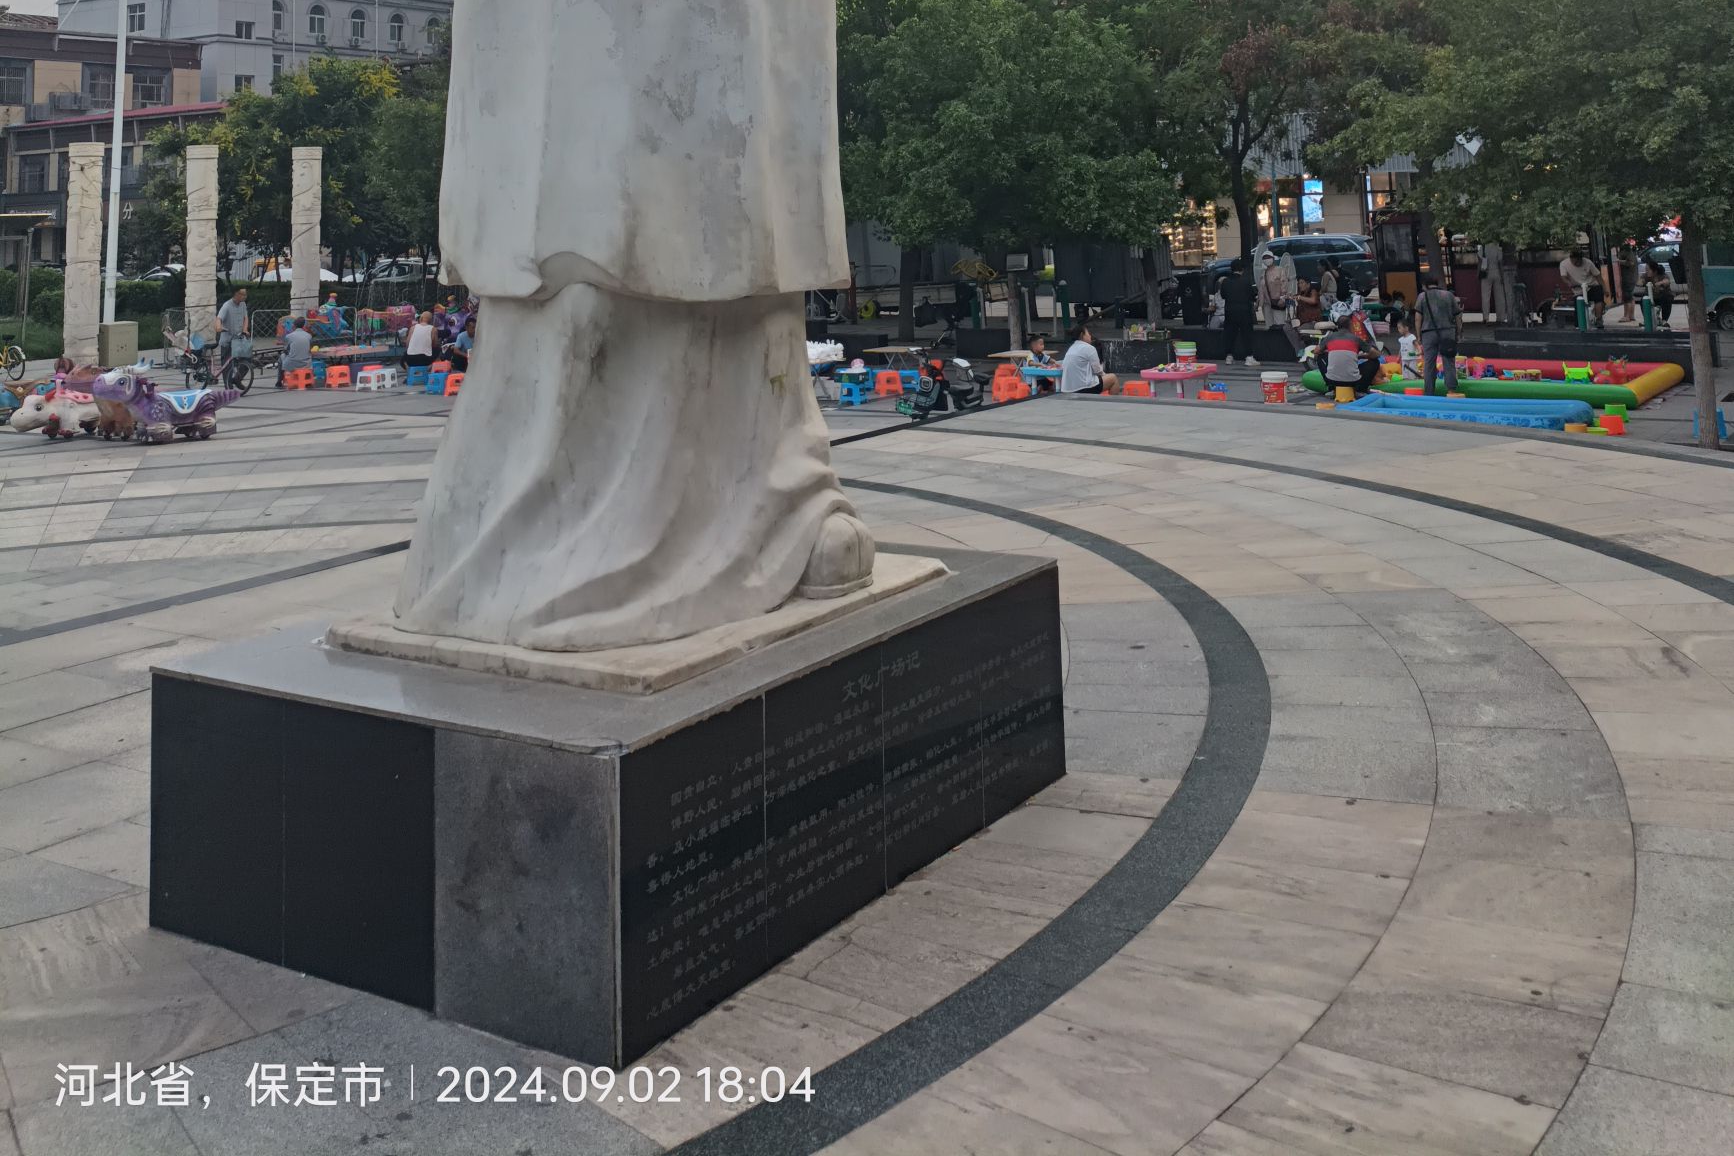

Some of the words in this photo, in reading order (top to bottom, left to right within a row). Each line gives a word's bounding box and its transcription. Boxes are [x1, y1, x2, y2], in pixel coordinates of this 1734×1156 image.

[841, 647, 921, 704] 文化广场记
